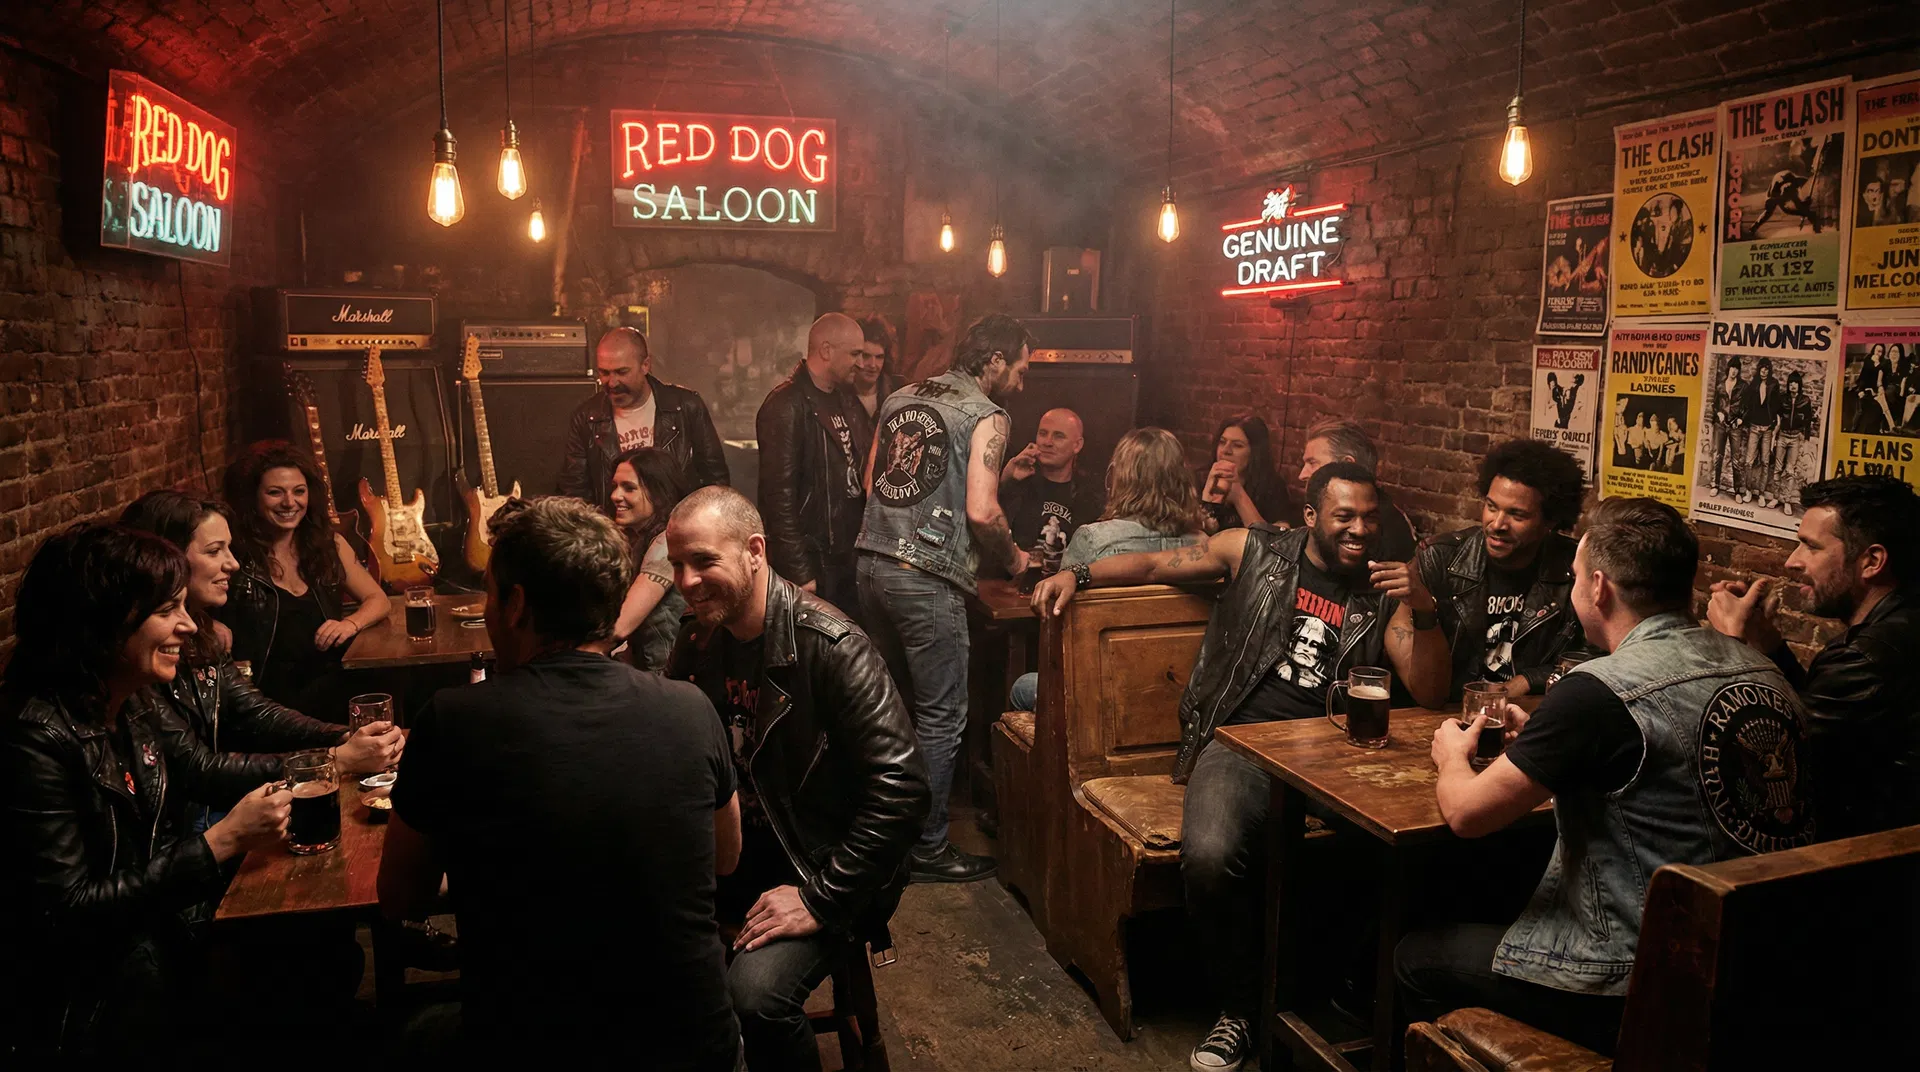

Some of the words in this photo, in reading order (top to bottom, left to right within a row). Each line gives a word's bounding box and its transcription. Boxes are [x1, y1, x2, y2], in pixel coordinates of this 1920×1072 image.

[1730, 103, 1767, 139] THE
[1774, 86, 1845, 131] CLASH
[127, 94, 183, 174] RED
[185, 121, 231, 201] DOG
[622, 122, 715, 178] RED
[730, 125, 828, 183] DOG
[1622, 143, 1652, 169] THE
[1658, 131, 1714, 163] CLASH
[129, 181, 222, 253] SALOON
[633, 183, 818, 224] SALOON
[1222, 216, 1340, 259] GENUINE
[1750, 251, 1770, 261] THE
[1772, 249, 1807, 260] CLASH
[1237, 250, 1326, 286] DRAFT
[1739, 262, 1775, 278] ARK
[1853, 271, 1920, 289] MELCO
[332, 303, 394, 323] Marshall
[1712, 321, 1832, 352] RAMONES
[1612, 351, 1699, 377] RANDYCANES
[1849, 437, 1914, 462] ELANS
[1708, 686, 1794, 733] RAMONES
